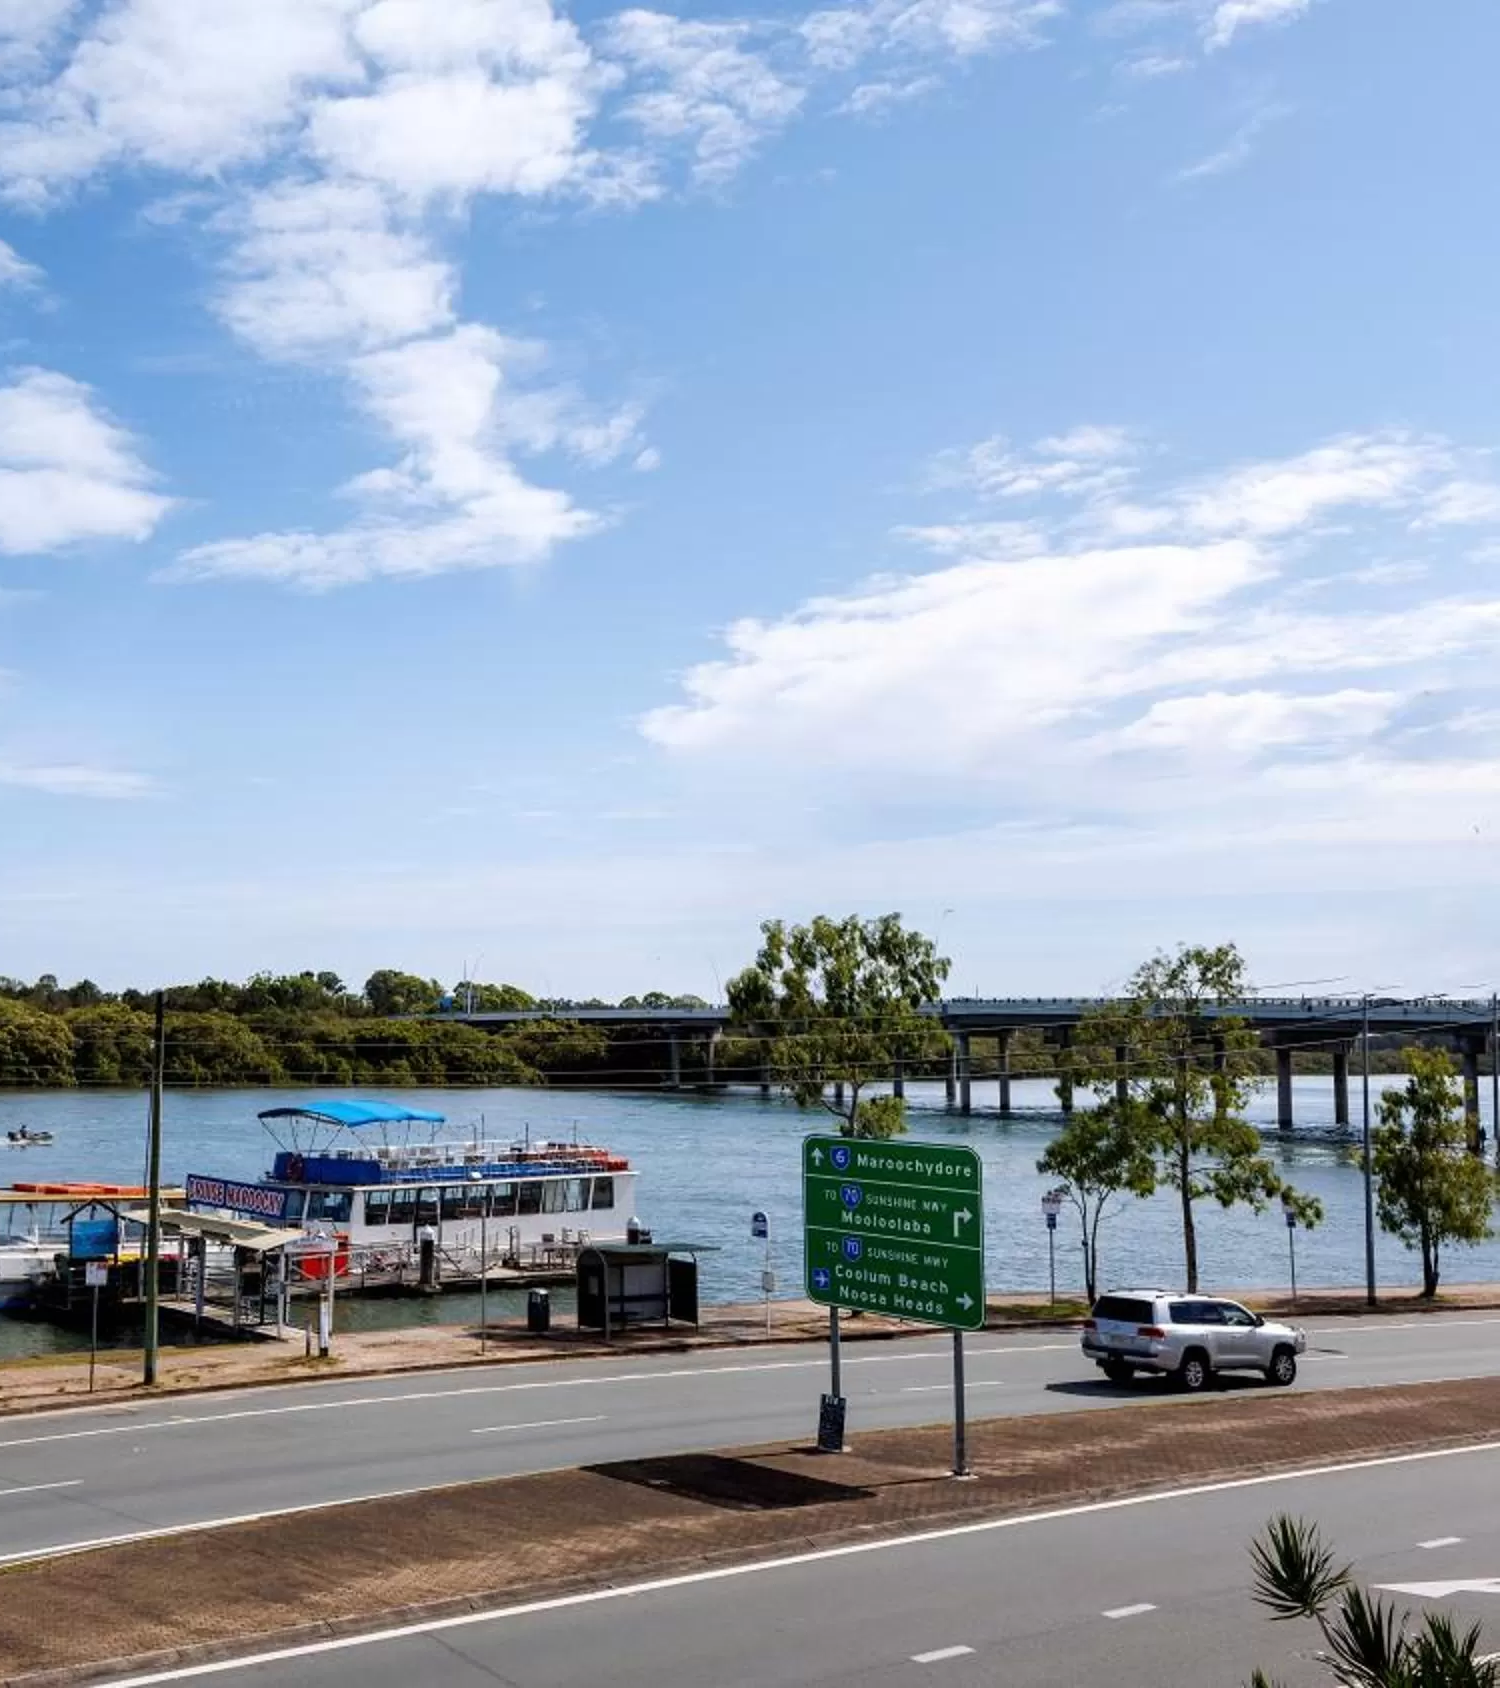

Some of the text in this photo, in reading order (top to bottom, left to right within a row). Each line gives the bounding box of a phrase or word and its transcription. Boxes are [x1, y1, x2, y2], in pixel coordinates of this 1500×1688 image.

[835, 1149, 972, 1177] 6 Maroochydore
[824, 1189, 837, 1201] TO
[866, 1193, 917, 1210] SUNSHINE
[841, 1210, 931, 1234] Mooloolaba
[825, 1241, 838, 1253] TO
[867, 1247, 919, 1265] SUNSHINE
[835, 1264, 949, 1295] Coolum Beach
[839, 1285, 944, 1315] Noosa Heads
